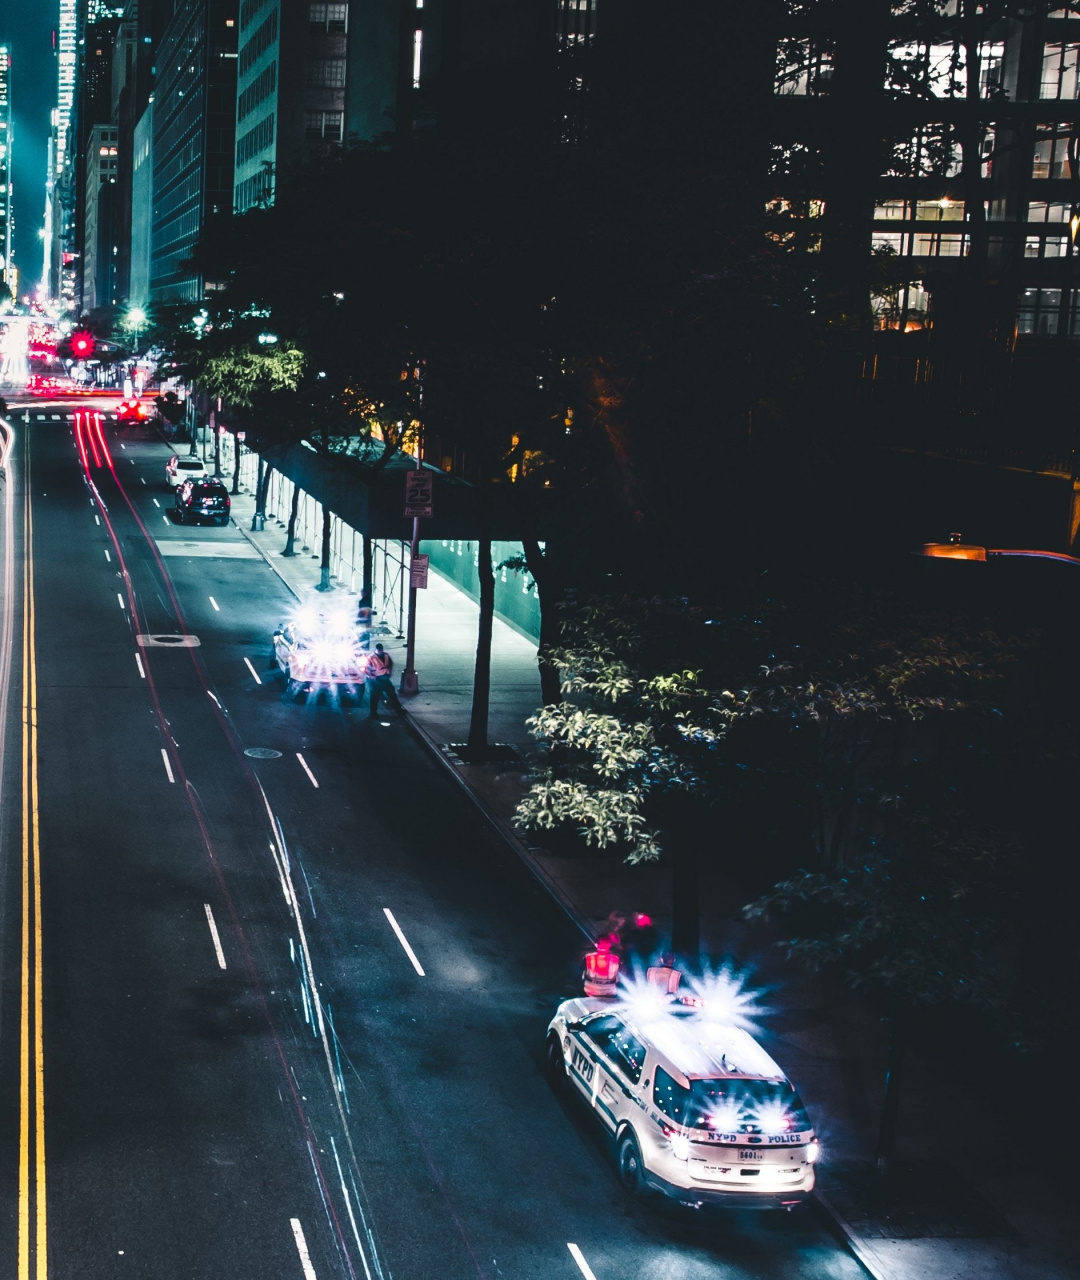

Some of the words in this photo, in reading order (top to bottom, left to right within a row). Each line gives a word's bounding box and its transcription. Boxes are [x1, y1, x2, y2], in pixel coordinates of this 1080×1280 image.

[408, 489, 430, 502] 25
[571, 1045, 594, 1083] NYPD
[708, 1132, 737, 1142] NYPD
[767, 1134, 801, 1143] POLICE
